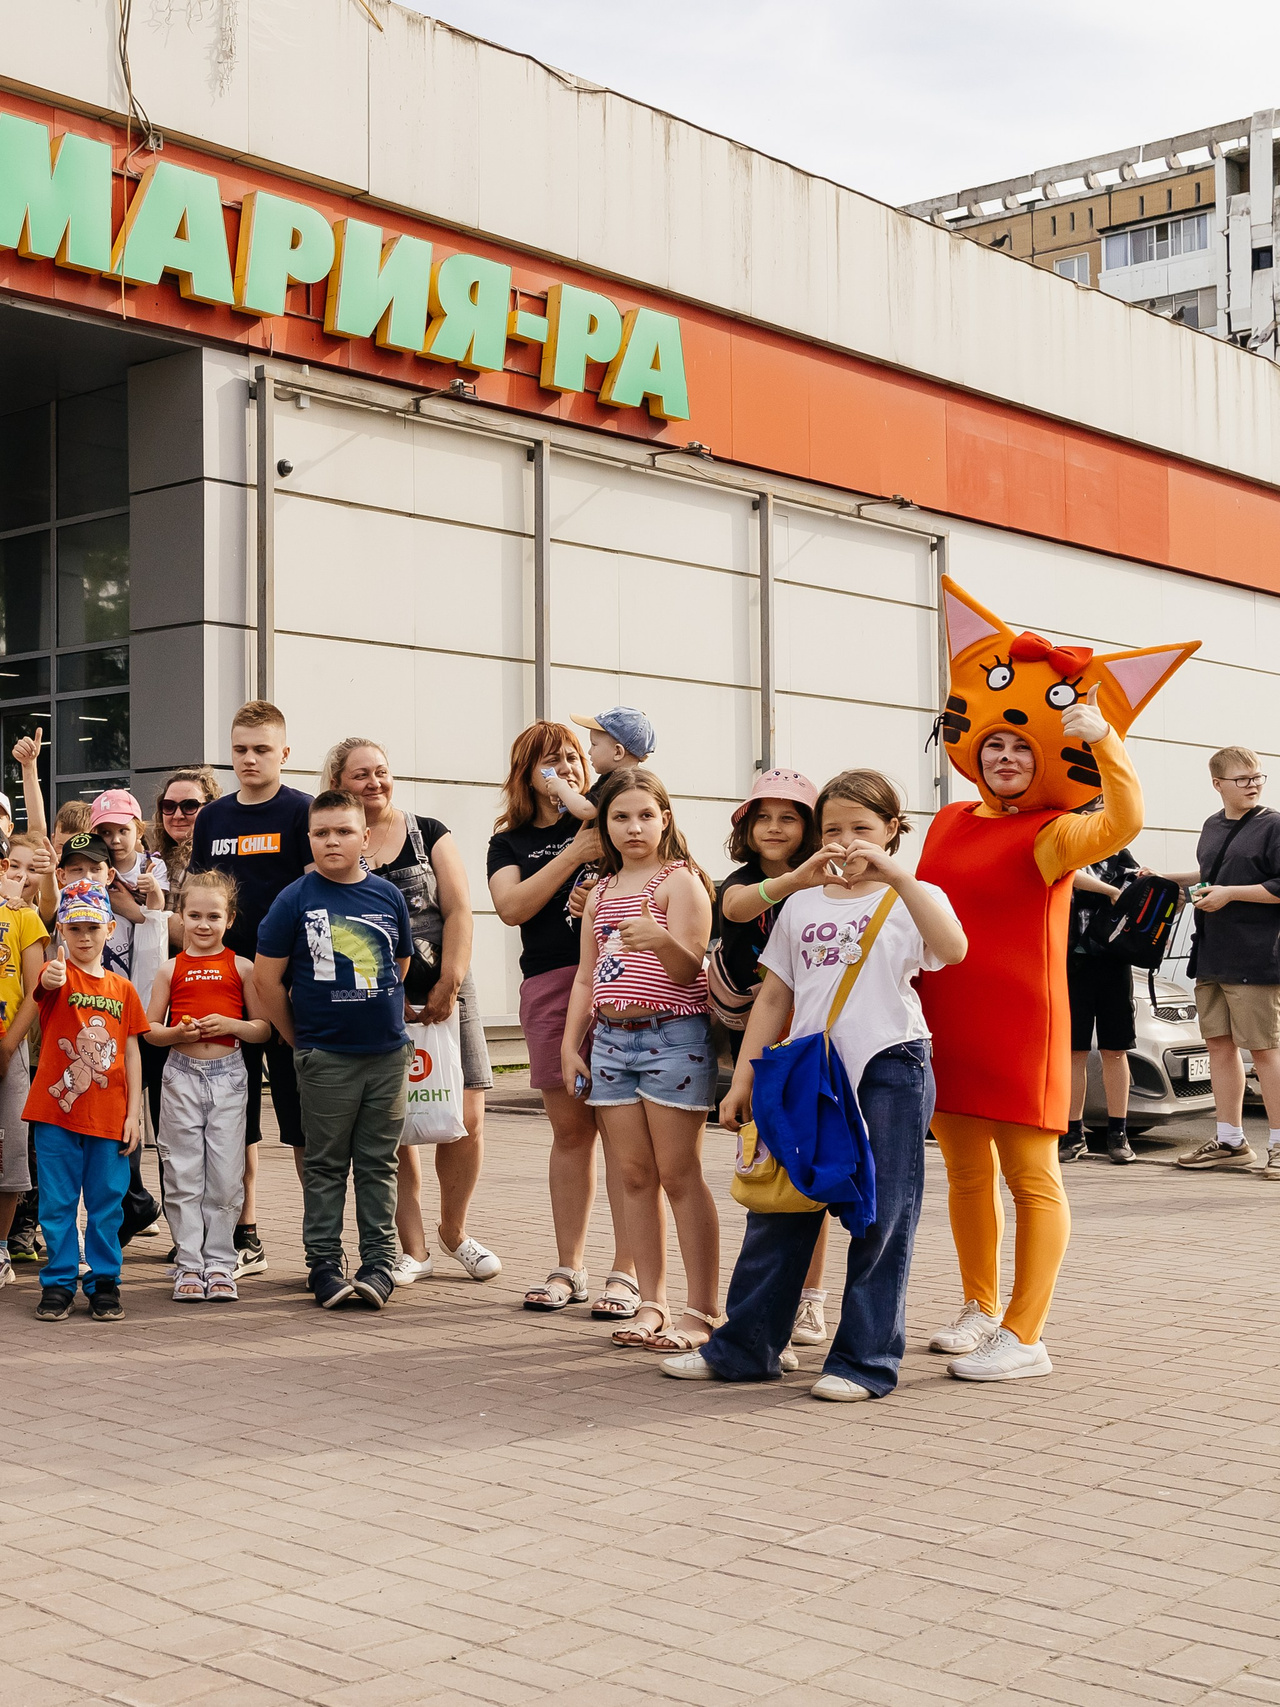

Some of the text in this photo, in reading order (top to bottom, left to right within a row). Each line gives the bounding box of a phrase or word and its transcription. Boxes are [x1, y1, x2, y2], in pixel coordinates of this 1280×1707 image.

[211, 836, 279, 857] JUST CHILL.
[801, 914, 872, 943] GOD
[195, 974, 223, 982] Paris?
[203, 968, 220, 976] you
[407, 1089, 451, 1102] иант
